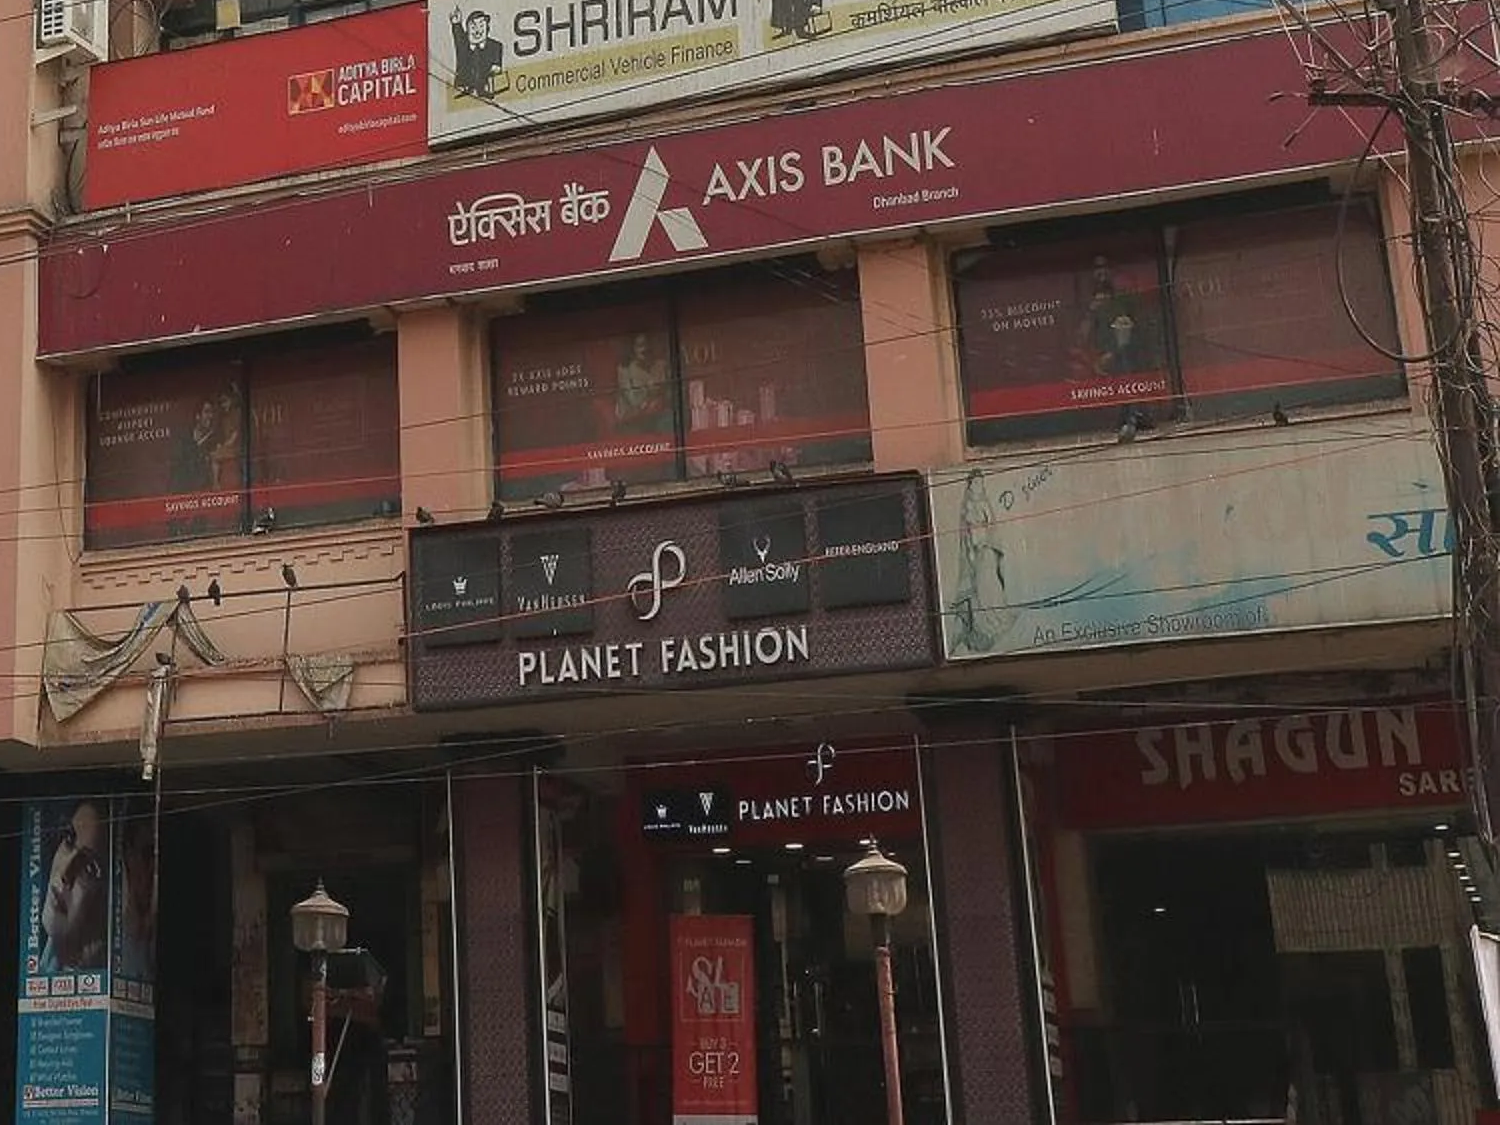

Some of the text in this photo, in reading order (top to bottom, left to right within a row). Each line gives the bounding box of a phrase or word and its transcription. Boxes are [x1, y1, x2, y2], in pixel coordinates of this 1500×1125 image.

[338, 54, 417, 82] ADITYA BIRLA
[515, 39, 733, 94] Commercial Vehicle Finance
[338, 73, 417, 106] CAPITAL
[196, 104, 215, 116] Fund
[702, 127, 955, 206] AXIS BANK
[561, 181, 610, 226] बैंक
[874, 186, 959, 210] Dhanbad Branch
[1013, 315, 1055, 331] MOVIES
[1071, 379, 1166, 401] SAVINGS ACCOUNT
[627, 441, 671, 457] ACCOUNT
[201, 494, 240, 509] ACCOUNT
[729, 560, 801, 586] Allen Solly
[1033, 623, 1056, 644] An
[1062, 619, 1142, 642] Exclusive
[518, 625, 809, 686] PLANET FASHION
[1134, 708, 1422, 790] SHAGUN
[739, 790, 910, 821] PLANET FASHION
[689, 1052, 740, 1075] GET 2
[67, 1082, 99, 1097] Vision
